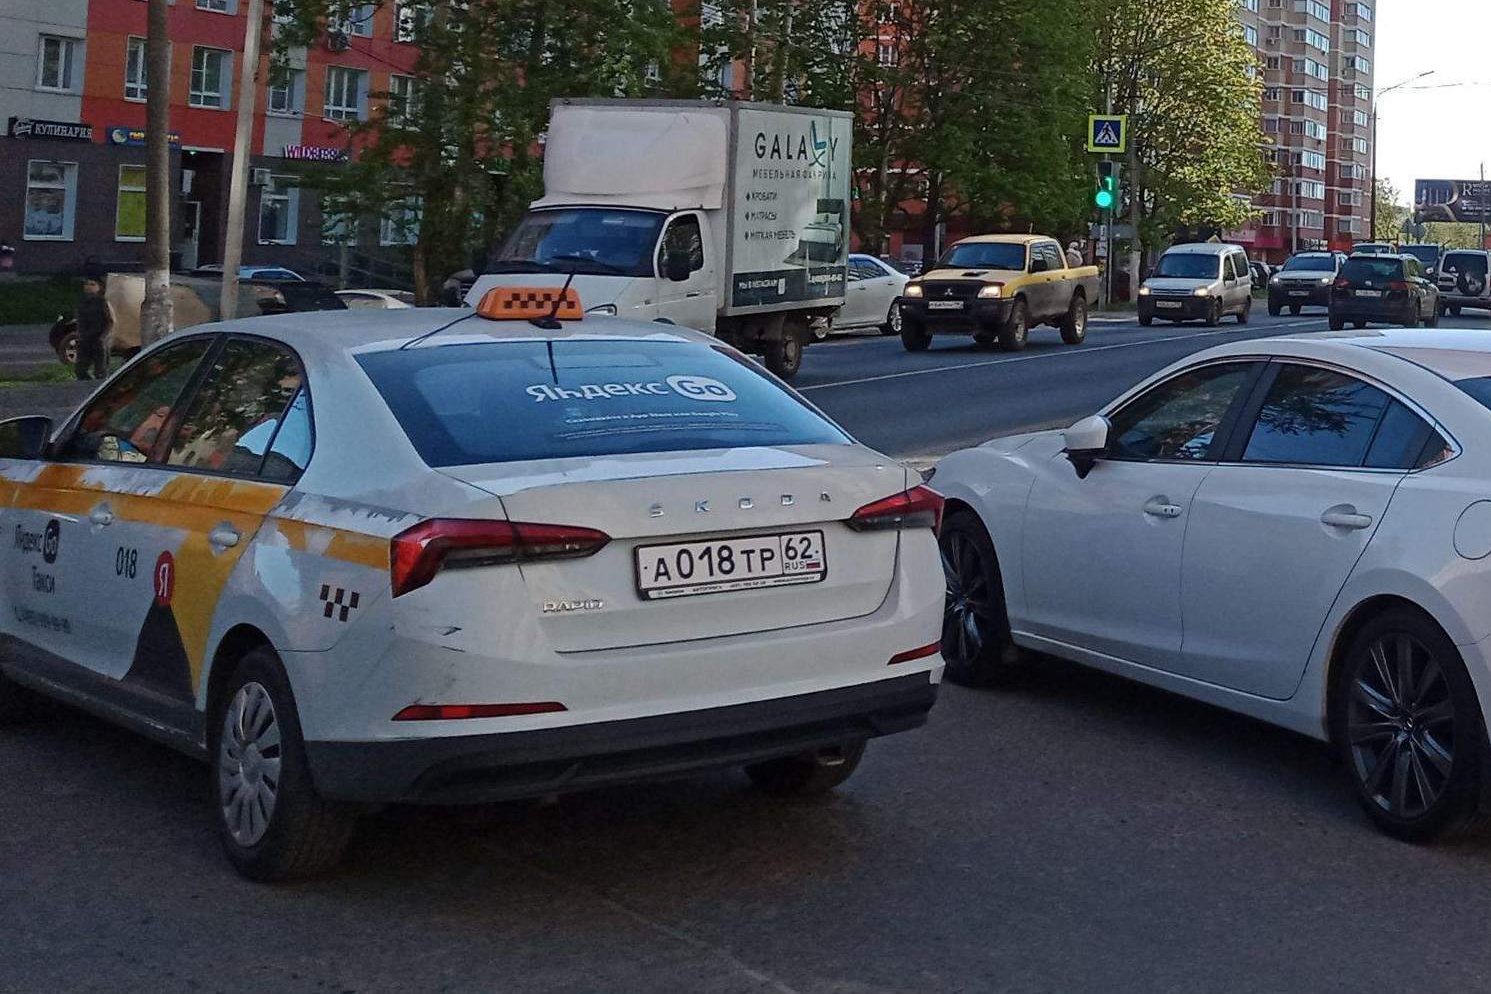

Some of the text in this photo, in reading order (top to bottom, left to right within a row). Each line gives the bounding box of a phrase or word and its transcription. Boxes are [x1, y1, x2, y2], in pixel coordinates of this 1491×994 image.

[35, 123, 93, 139] КУЛИНАРИЯ
[753, 168, 800, 180] МЕБЕЛЬНАЯ
[526, 378, 732, 402] Яндекс Go
[784, 537, 813, 560] 62
[116, 547, 137, 579] 018
[784, 561, 805, 571] RUS
[158, 563, 169, 597] Я
